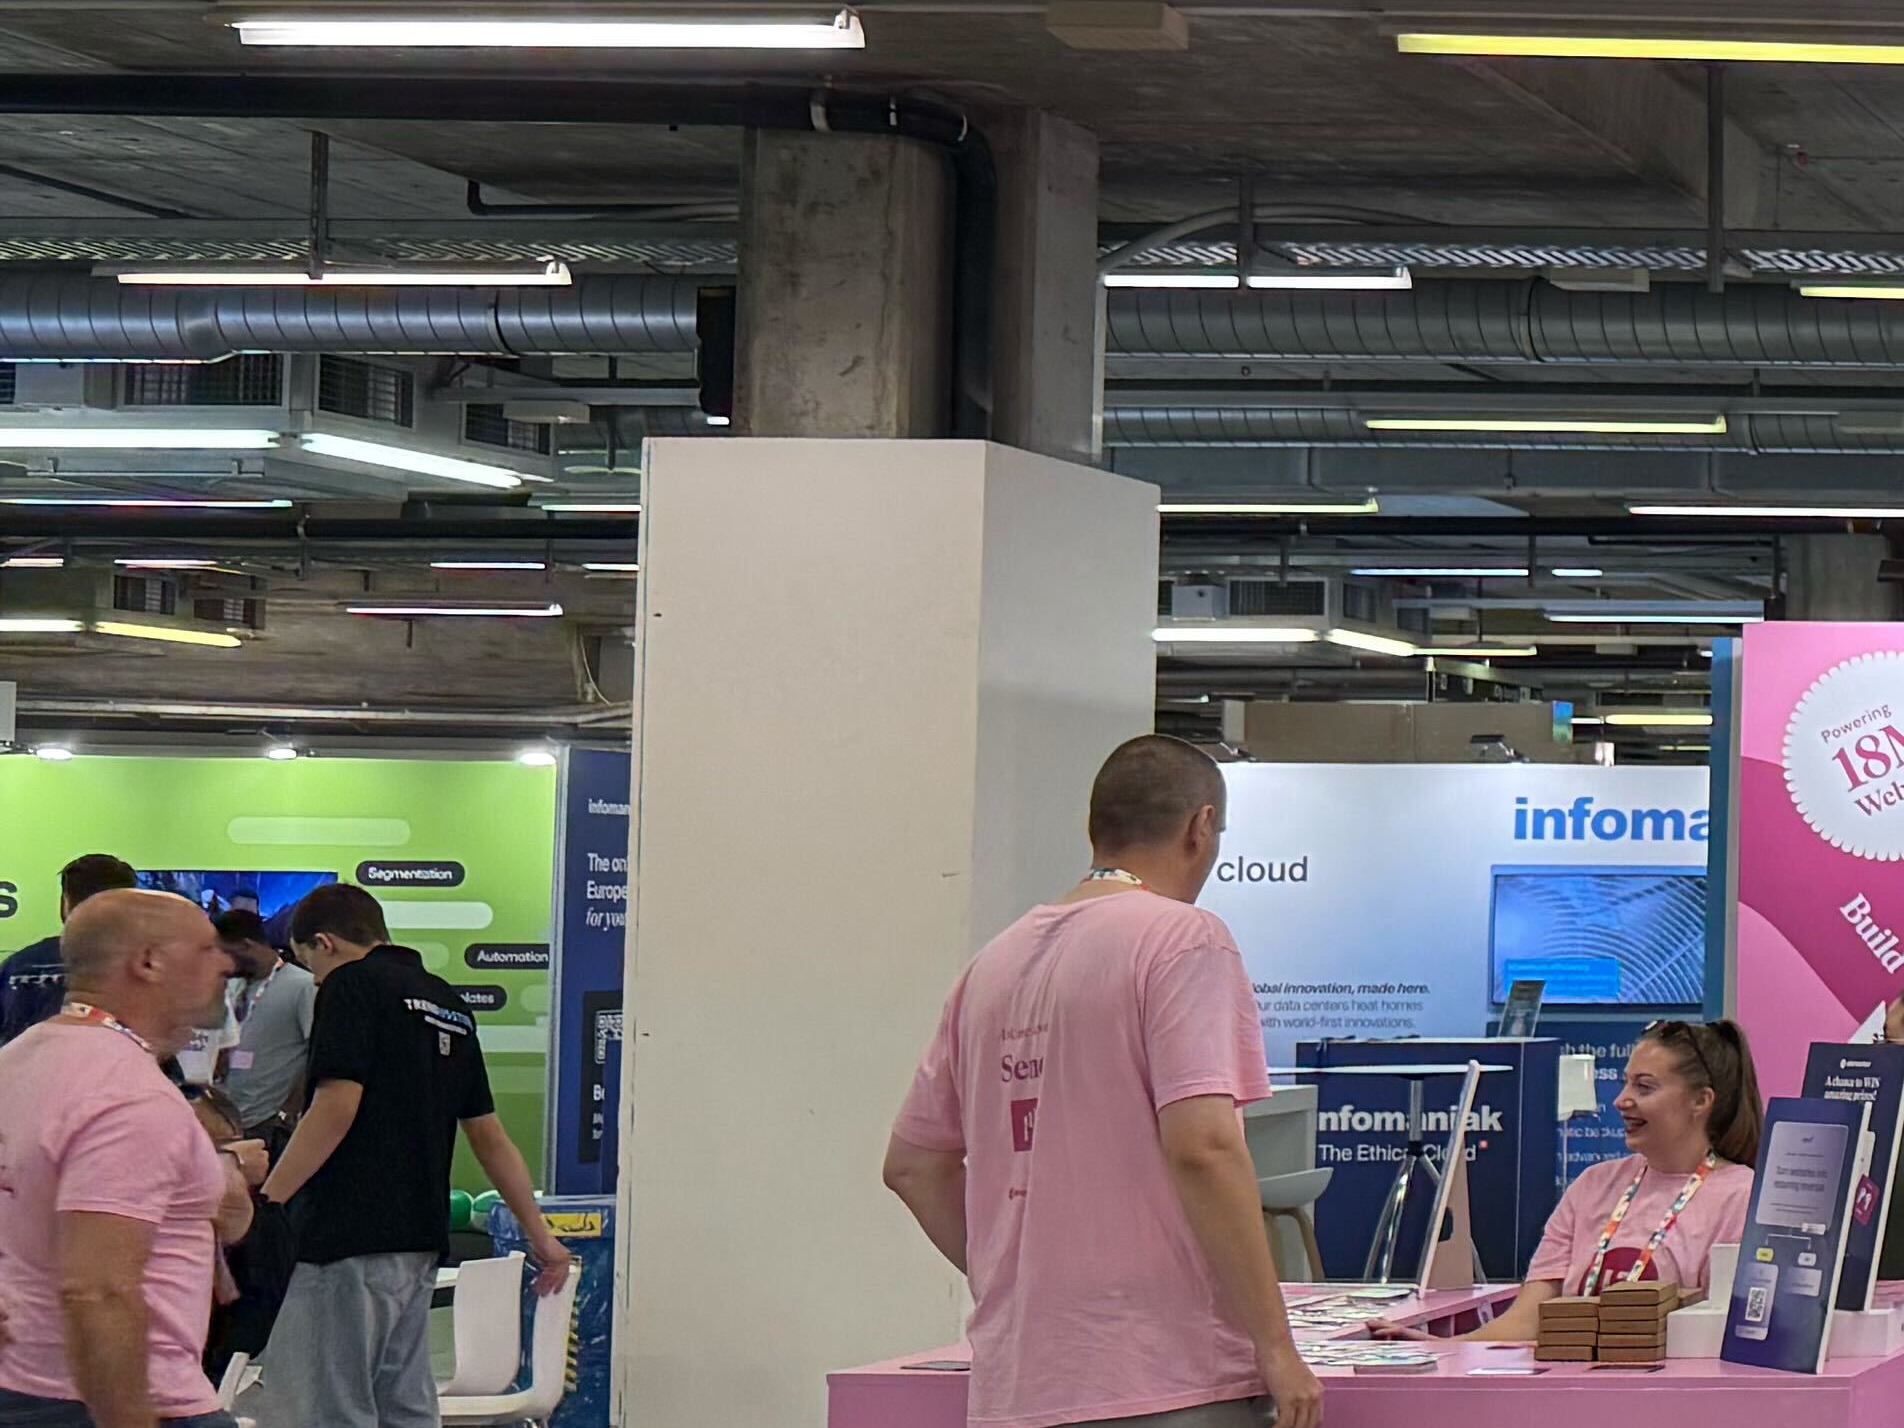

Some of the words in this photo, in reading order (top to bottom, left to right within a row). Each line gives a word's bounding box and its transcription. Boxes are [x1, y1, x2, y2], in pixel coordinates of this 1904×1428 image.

[1821, 704, 1892, 743] Powering
[368, 866, 453, 881] Segmentation
[1217, 856, 1308, 882] cloud
[477, 950, 549, 963] Automation
[1357, 982, 1395, 994] made
[1318, 1105, 1504, 1131] nfomniak
[1319, 1144, 1352, 1161] The
[1357, 1144, 1409, 1162] Ethic
